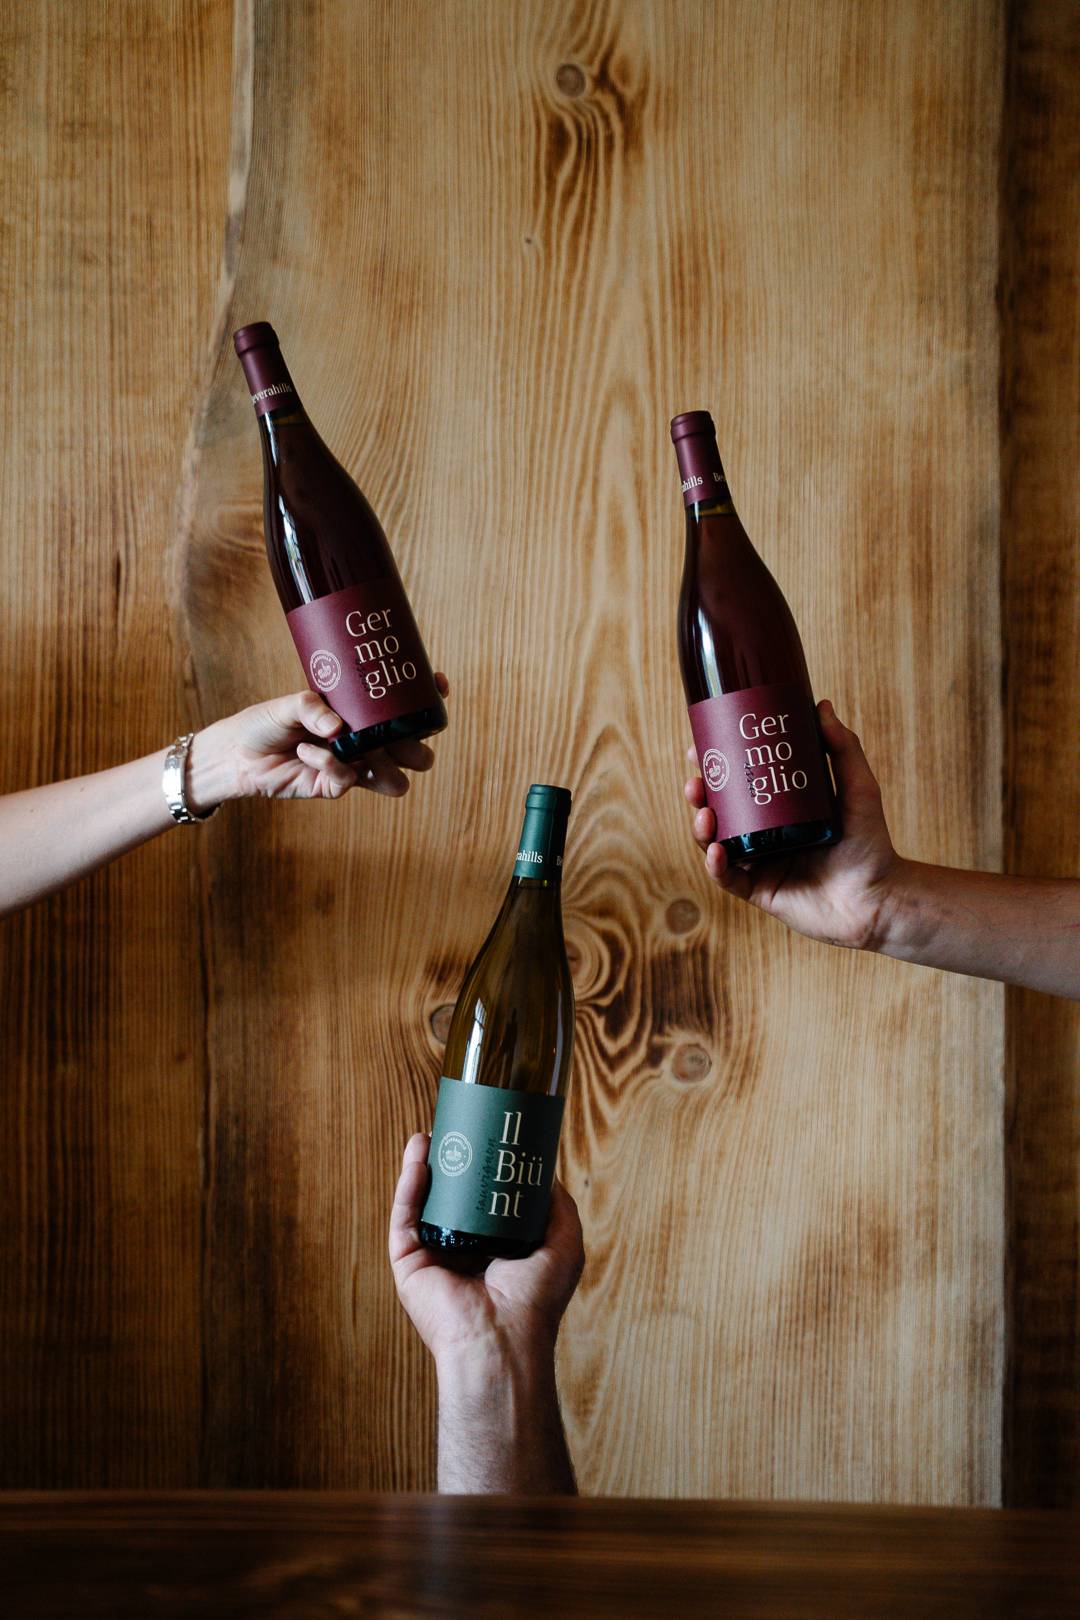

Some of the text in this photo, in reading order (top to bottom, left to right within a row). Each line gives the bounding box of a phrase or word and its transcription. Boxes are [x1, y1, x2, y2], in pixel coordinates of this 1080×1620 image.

[345, 608, 392, 637] Ger
[354, 635, 400, 664] mo
[365, 658, 417, 700] glio
[739, 713, 790, 740] Ger
[744, 741, 793, 768] mo
[752, 765, 808, 806] glio
[499, 1111, 522, 1146] Il
[493, 1149, 544, 1187] Biü
[487, 1190, 525, 1218] nt
